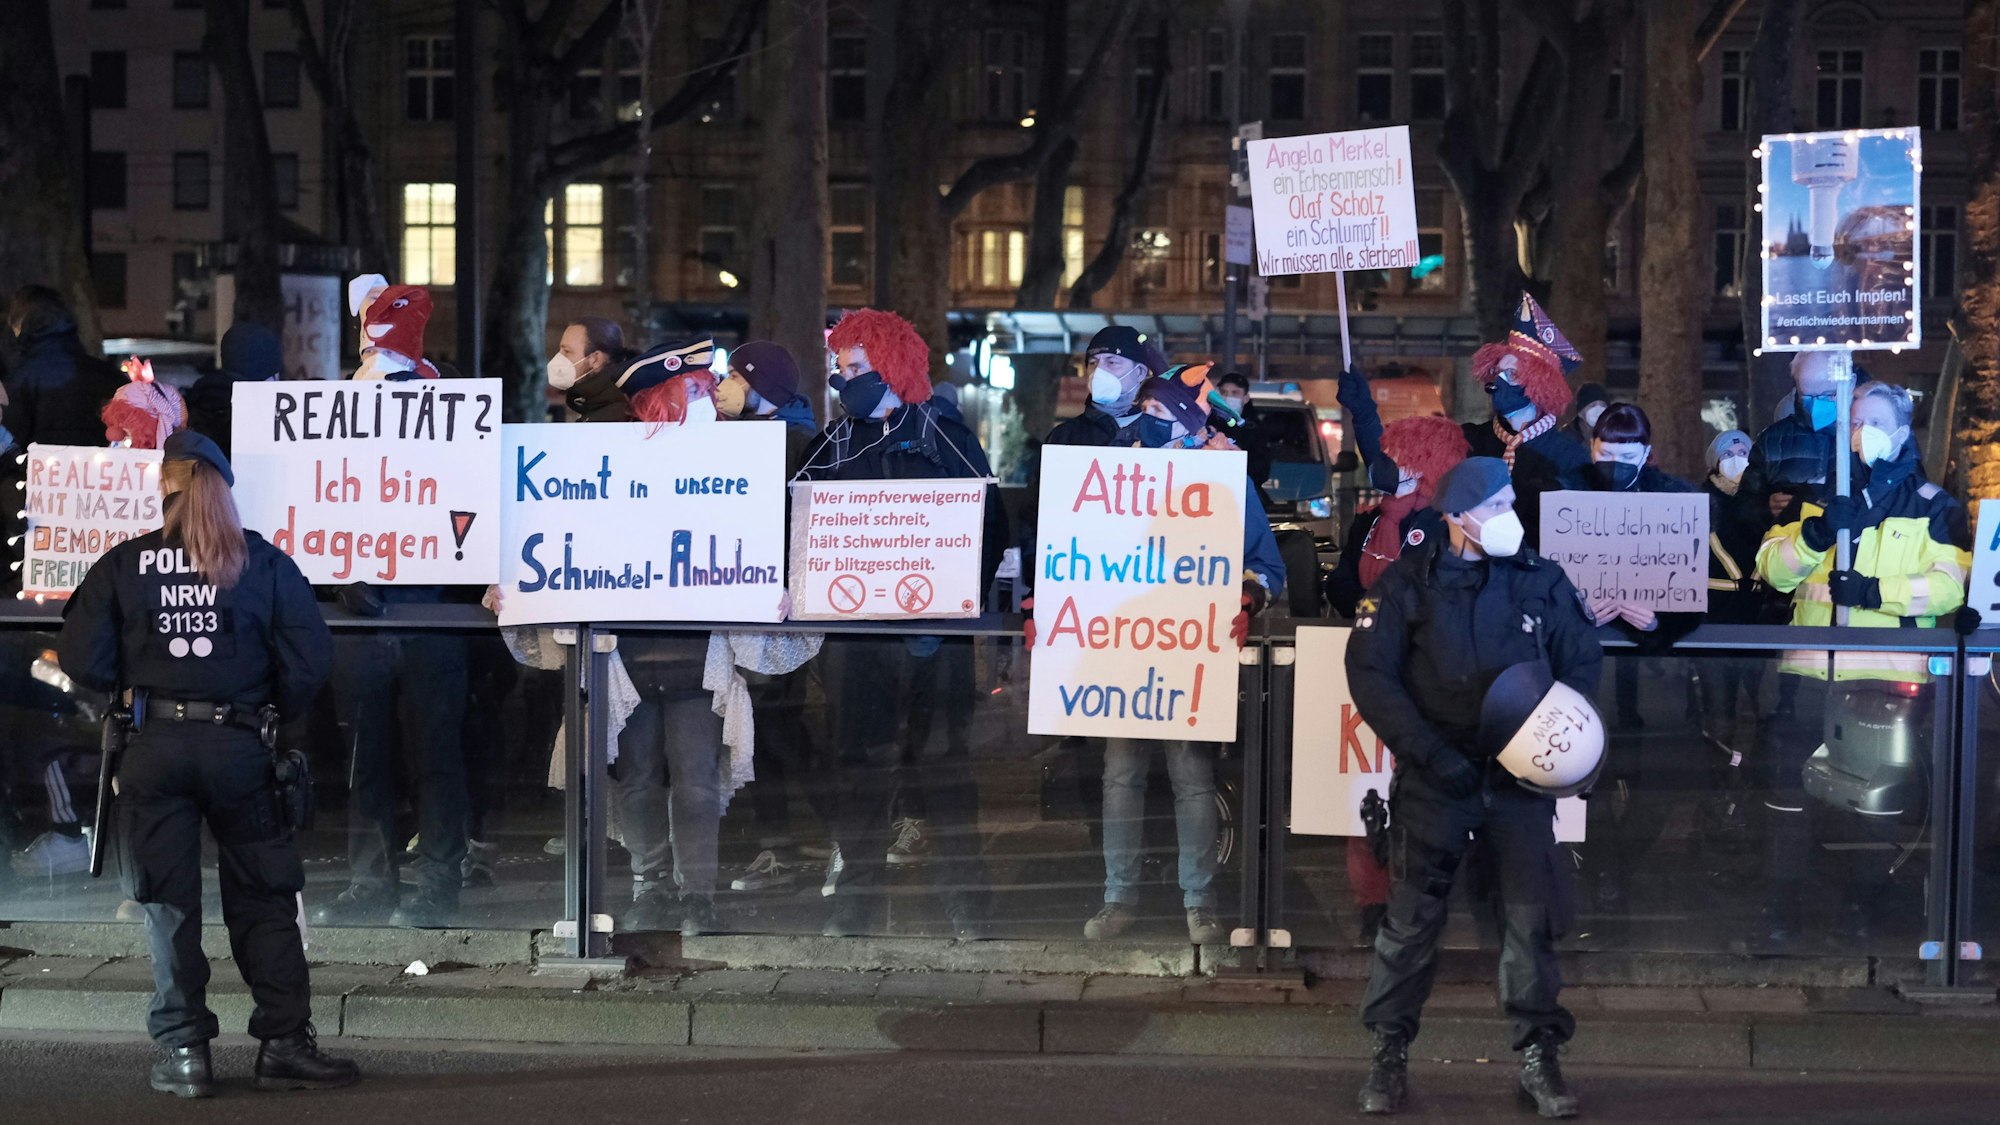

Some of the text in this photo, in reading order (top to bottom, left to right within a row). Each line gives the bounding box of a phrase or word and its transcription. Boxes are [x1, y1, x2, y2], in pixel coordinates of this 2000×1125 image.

[1265, 132, 1391, 172] Angela Merkel
[1273, 158, 1402, 195] ein Echsenmensch!
[1289, 190, 1385, 219] Olaf Scholz
[1286, 215, 1390, 248] ein Schlumpf!!
[1258, 240, 1418, 274] Wir müssen alle sterben!!!
[1776, 288, 1906, 306] Lasst Euch Impfen!
[1776, 315, 1904, 327] #endlichwiederumarmen
[315, 456, 438, 505] Ich bin
[517, 446, 749, 502] Kommt in unsere
[1072, 457, 1214, 518] Attila
[28, 490, 158, 521] MIT NAZIS
[813, 490, 981, 507] Wer impfverweigernd
[811, 512, 930, 528] Freiheit schreit,
[1555, 504, 1699, 537] Stell dich nicht
[809, 534, 972, 549] hält Schwurbler auch
[1597, 554, 1621, 566] zu
[1629, 538, 1700, 573] denken!
[517, 529, 779, 593] Schwindel-Ambulanz
[808, 557, 935, 575] für blitzgescheit.
[1045, 535, 1231, 586] ich will ein
[160, 584, 218, 607] NRW
[1592, 571, 1627, 601] dich
[1633, 571, 1703, 609] impfen.
[158, 611, 218, 634] 31133
[1047, 595, 1220, 653] Aerosol
[1532, 706, 1564, 743] NRW
